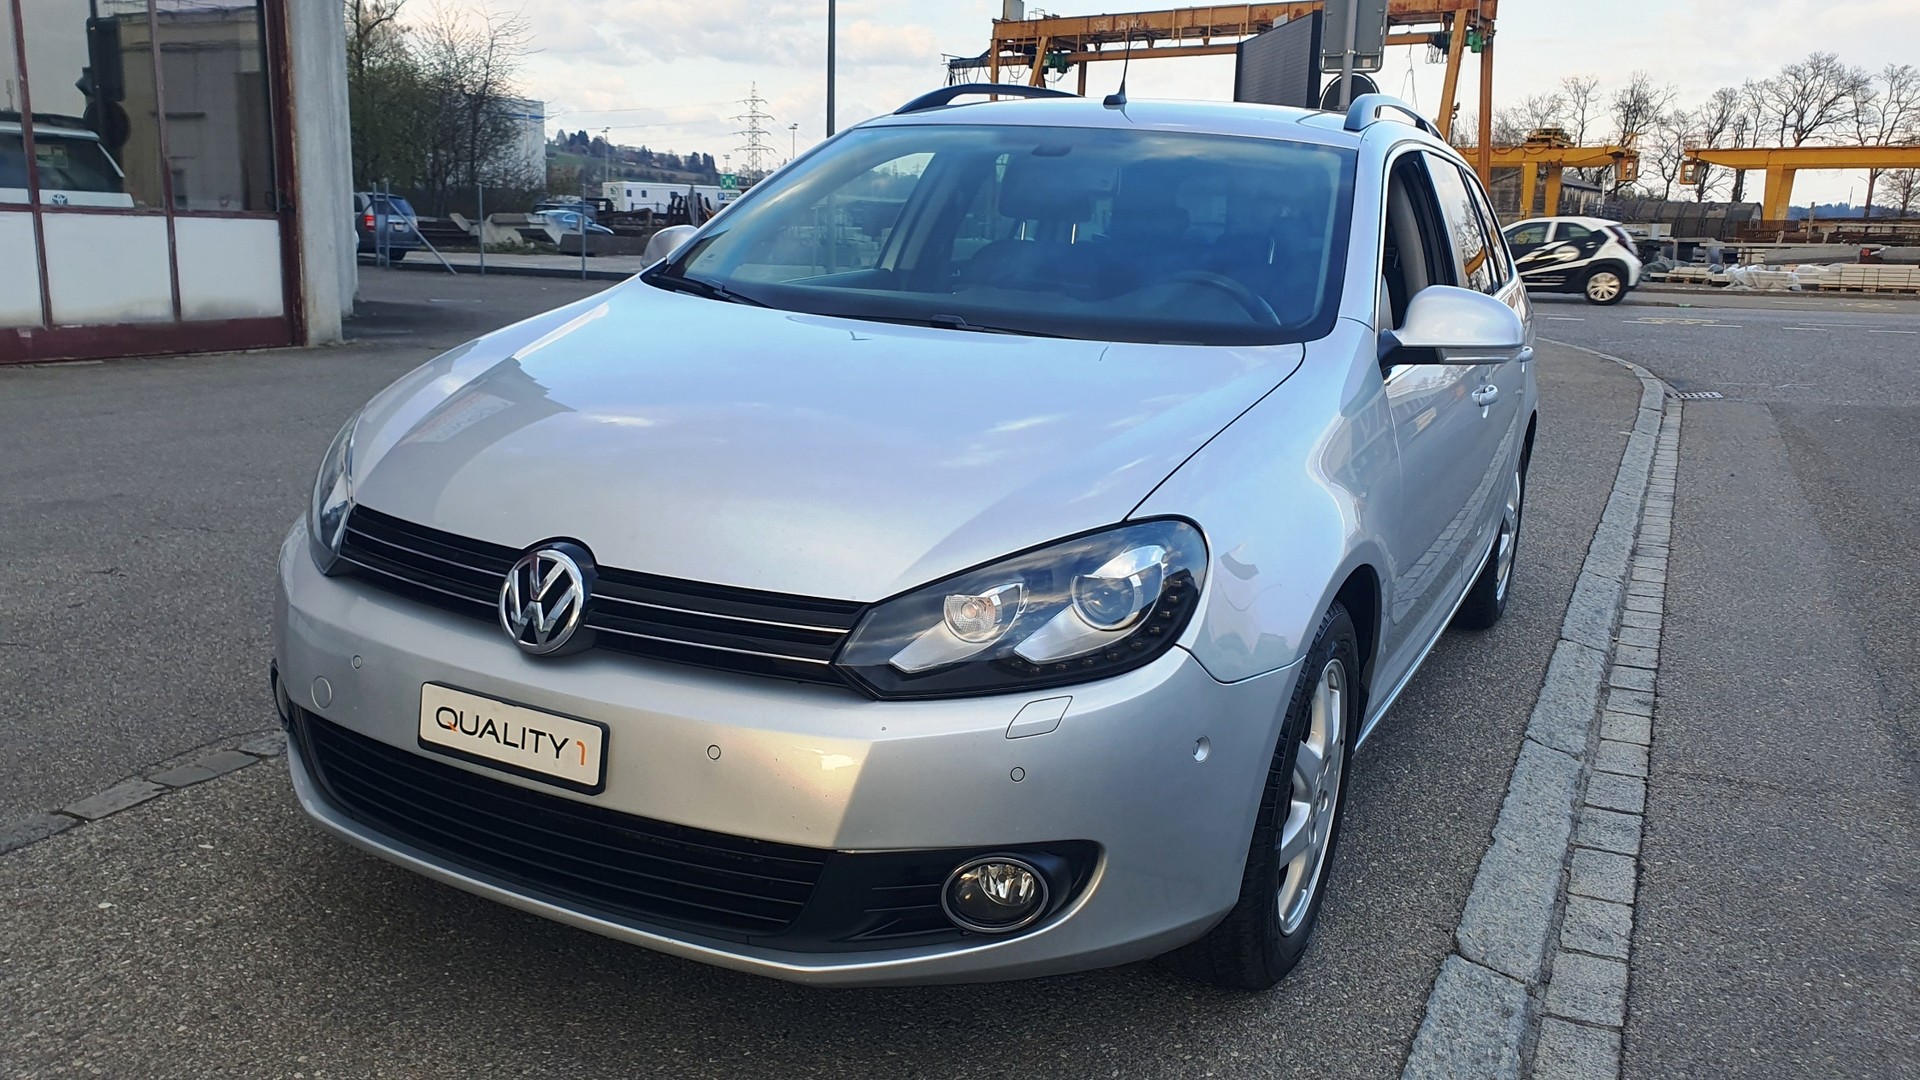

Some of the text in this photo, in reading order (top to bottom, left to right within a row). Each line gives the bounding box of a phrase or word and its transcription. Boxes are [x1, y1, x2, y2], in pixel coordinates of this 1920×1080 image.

[500, 550, 583, 653] VW
[435, 706, 587, 766] QUALITY 1
